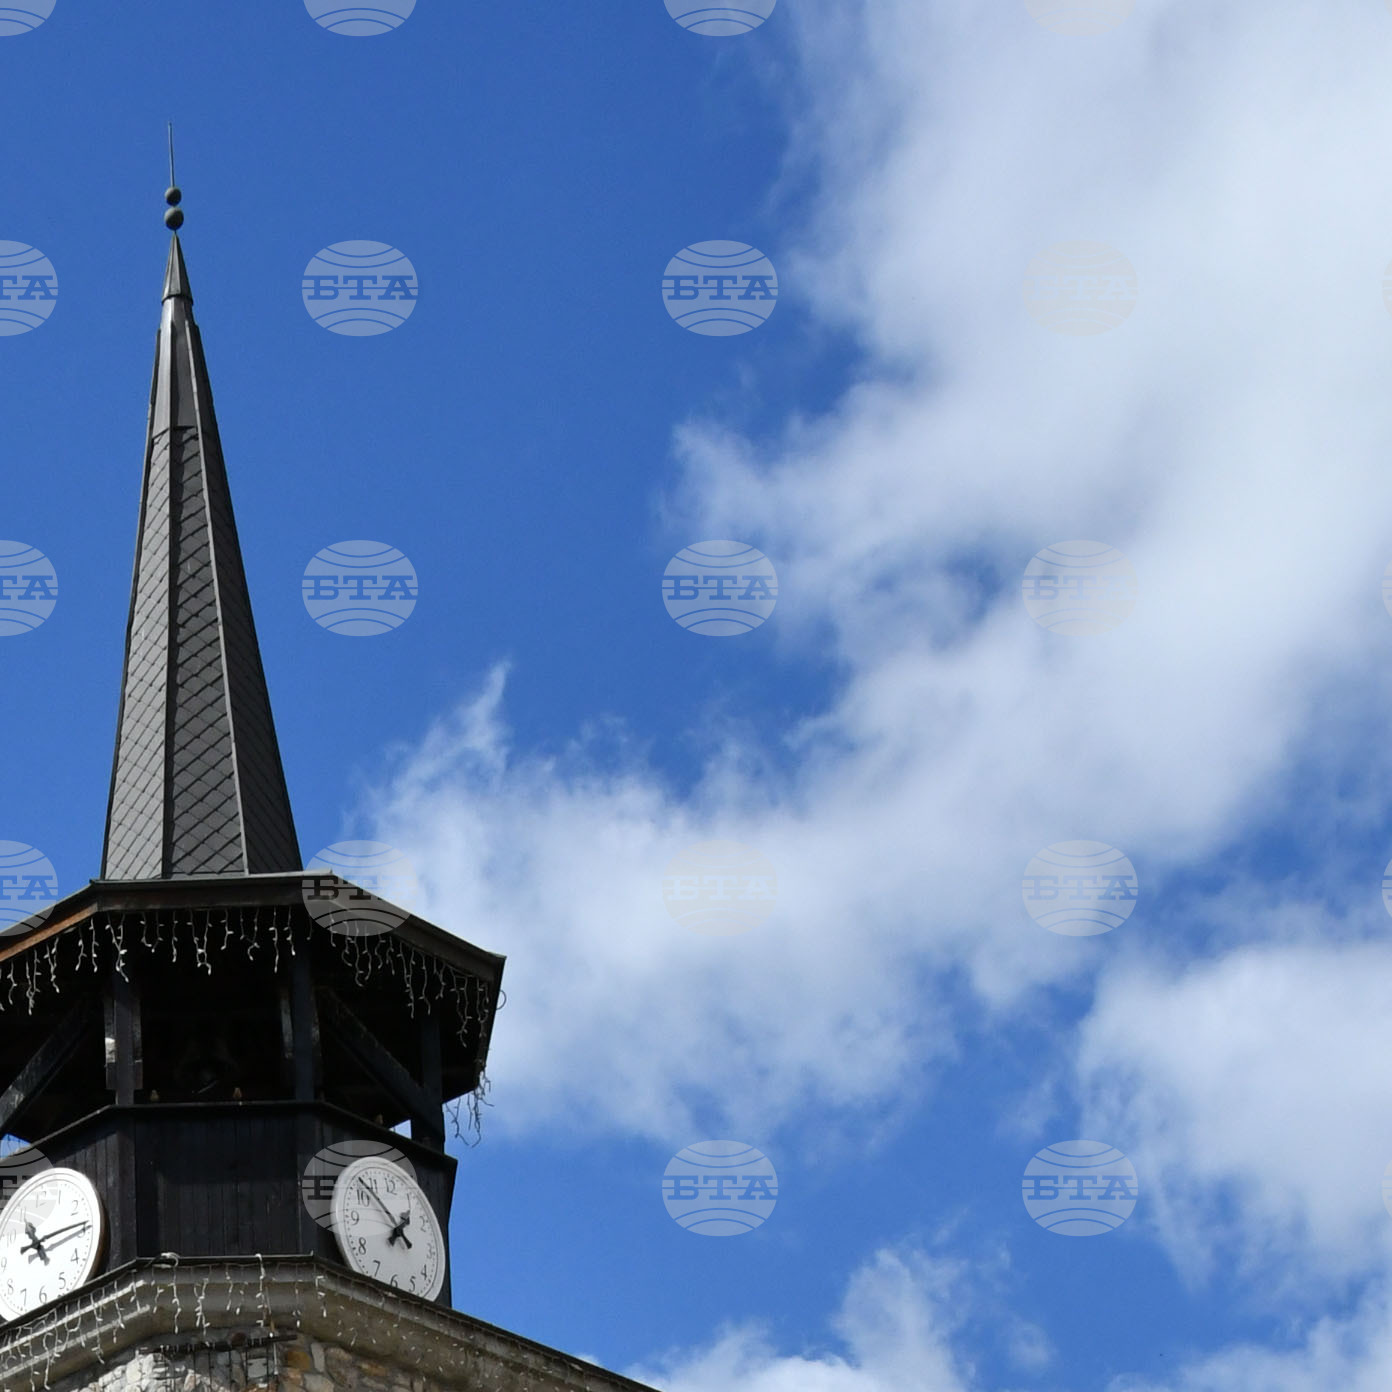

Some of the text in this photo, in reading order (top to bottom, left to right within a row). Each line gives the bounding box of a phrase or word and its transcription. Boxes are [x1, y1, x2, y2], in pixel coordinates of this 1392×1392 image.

[385, 1177, 398, 1195] 12
[357, 1189, 370, 1207] 10
[70, 1200, 79, 1217] 2
[351, 1211, 359, 1225] 9
[420, 1216, 428, 1232] 2
[359, 1237, 366, 1255] 8
[70, 1248, 80, 1264] 4
[1, 1257, 7, 1273] 9
[373, 1260, 381, 1277] 7
[421, 1264, 427, 1280] 4
[7, 1279, 14, 1295] 8
[58, 1272, 67, 1289] 5
[390, 1274, 398, 1288] 6
[409, 1276, 416, 1292] 5
[20, 1288, 27, 1306] 7
[39, 1285, 48, 1303] 6
